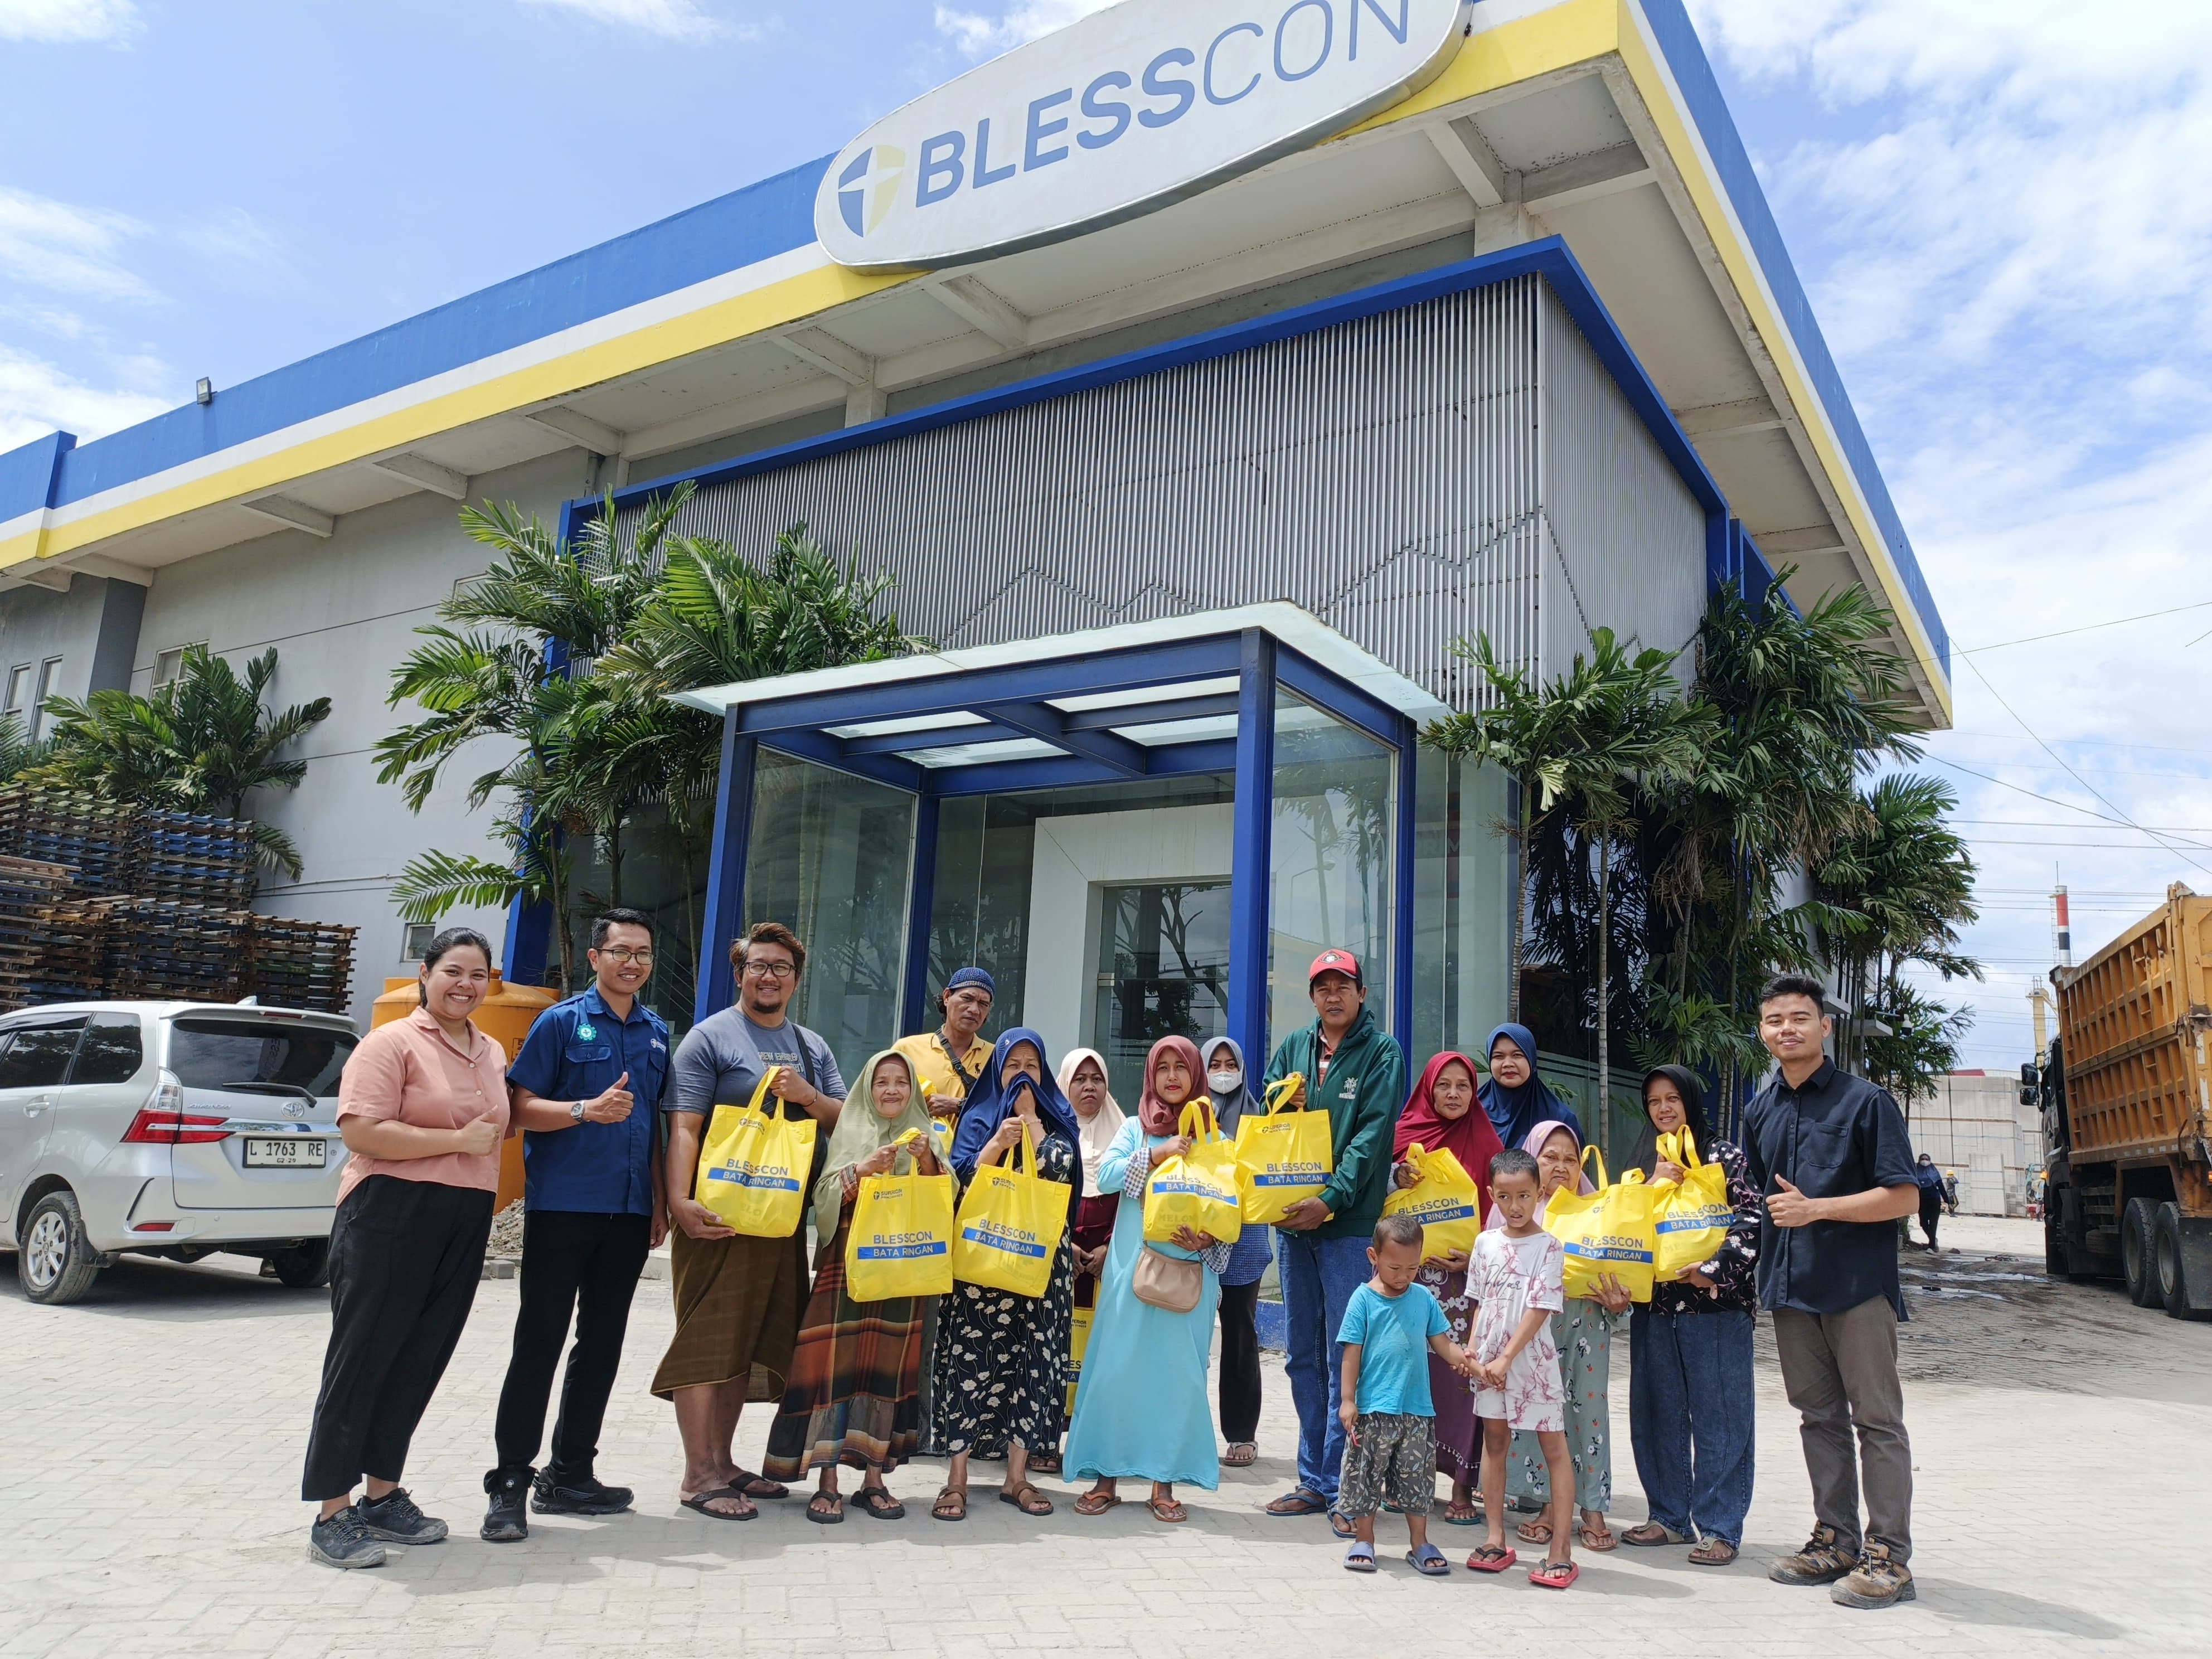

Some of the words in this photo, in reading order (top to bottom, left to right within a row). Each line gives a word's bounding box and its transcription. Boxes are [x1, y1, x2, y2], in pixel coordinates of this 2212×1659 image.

[916, 0, 1408, 207] BLESSCON
[250, 1142, 257, 1156] L
[266, 1142, 296, 1156] 1763
[308, 1143, 323, 1157] RE
[726, 1158, 788, 1176] BLESSCON
[1267, 1162, 1322, 1172] BLESSCON
[723, 1171, 747, 1183] BATA
[749, 1176, 785, 1187] RINGAN
[1268, 1175, 1292, 1183] BATA
[1293, 1174, 1323, 1183] RINGAN
[1194, 1185, 1225, 1200] RINGAN
[1398, 1197, 1459, 1214] BLESSCON
[1667, 1203, 1728, 1219] BLESSCON
[1426, 1209, 1461, 1221] RINGAN
[1670, 1221, 1697, 1229] BATA
[1700, 1216, 1730, 1228] RINGAN
[874, 1231, 932, 1244] BLESSCON
[979, 1219, 1035, 1241] BLESSCON
[975, 1231, 998, 1245] BATA
[1000, 1240, 1033, 1254] RINGAN
[874, 1248, 899, 1257] BATA
[902, 1245, 933, 1257] RINGAN
[1578, 1247, 1605, 1257] BATA
[1607, 1250, 1642, 1260] RINGAN
